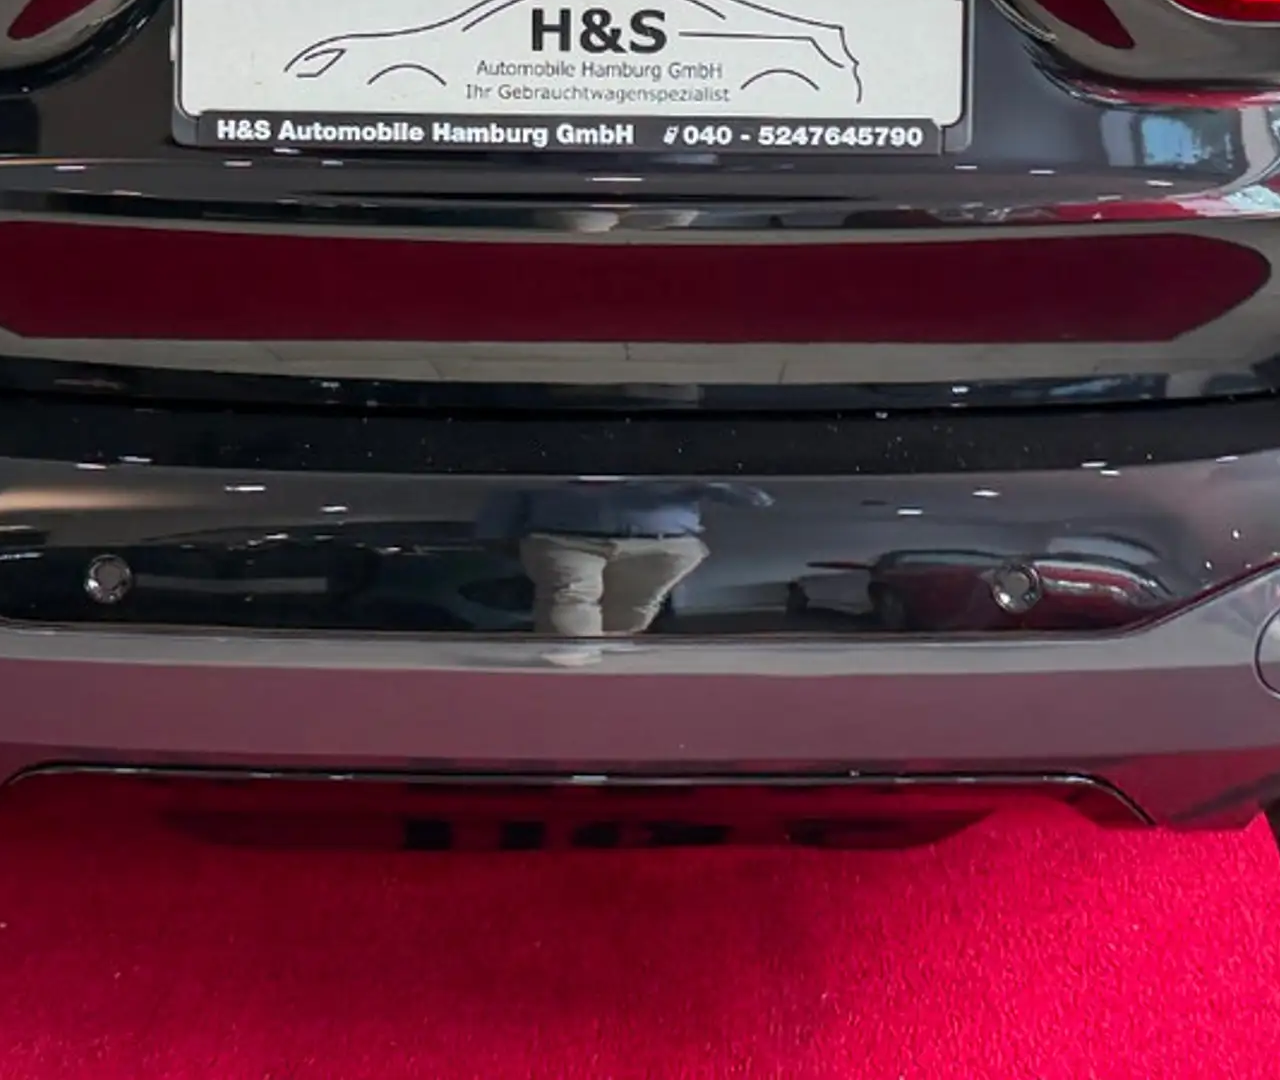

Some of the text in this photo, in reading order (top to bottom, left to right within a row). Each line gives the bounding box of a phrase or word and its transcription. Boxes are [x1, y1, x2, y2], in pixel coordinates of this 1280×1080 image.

[531, 8, 668, 53] H&S
[476, 60, 723, 81] Automobile Hamburg GmbH
[466, 84, 731, 104] Ihr Gebrauchtwagenspezialist
[216, 120, 271, 140] H&S
[278, 121, 424, 141] Automobile
[432, 122, 548, 147] Hamburg
[556, 123, 634, 145] GmbH
[682, 126, 732, 146] 040
[758, 126, 923, 148] 5247645790
